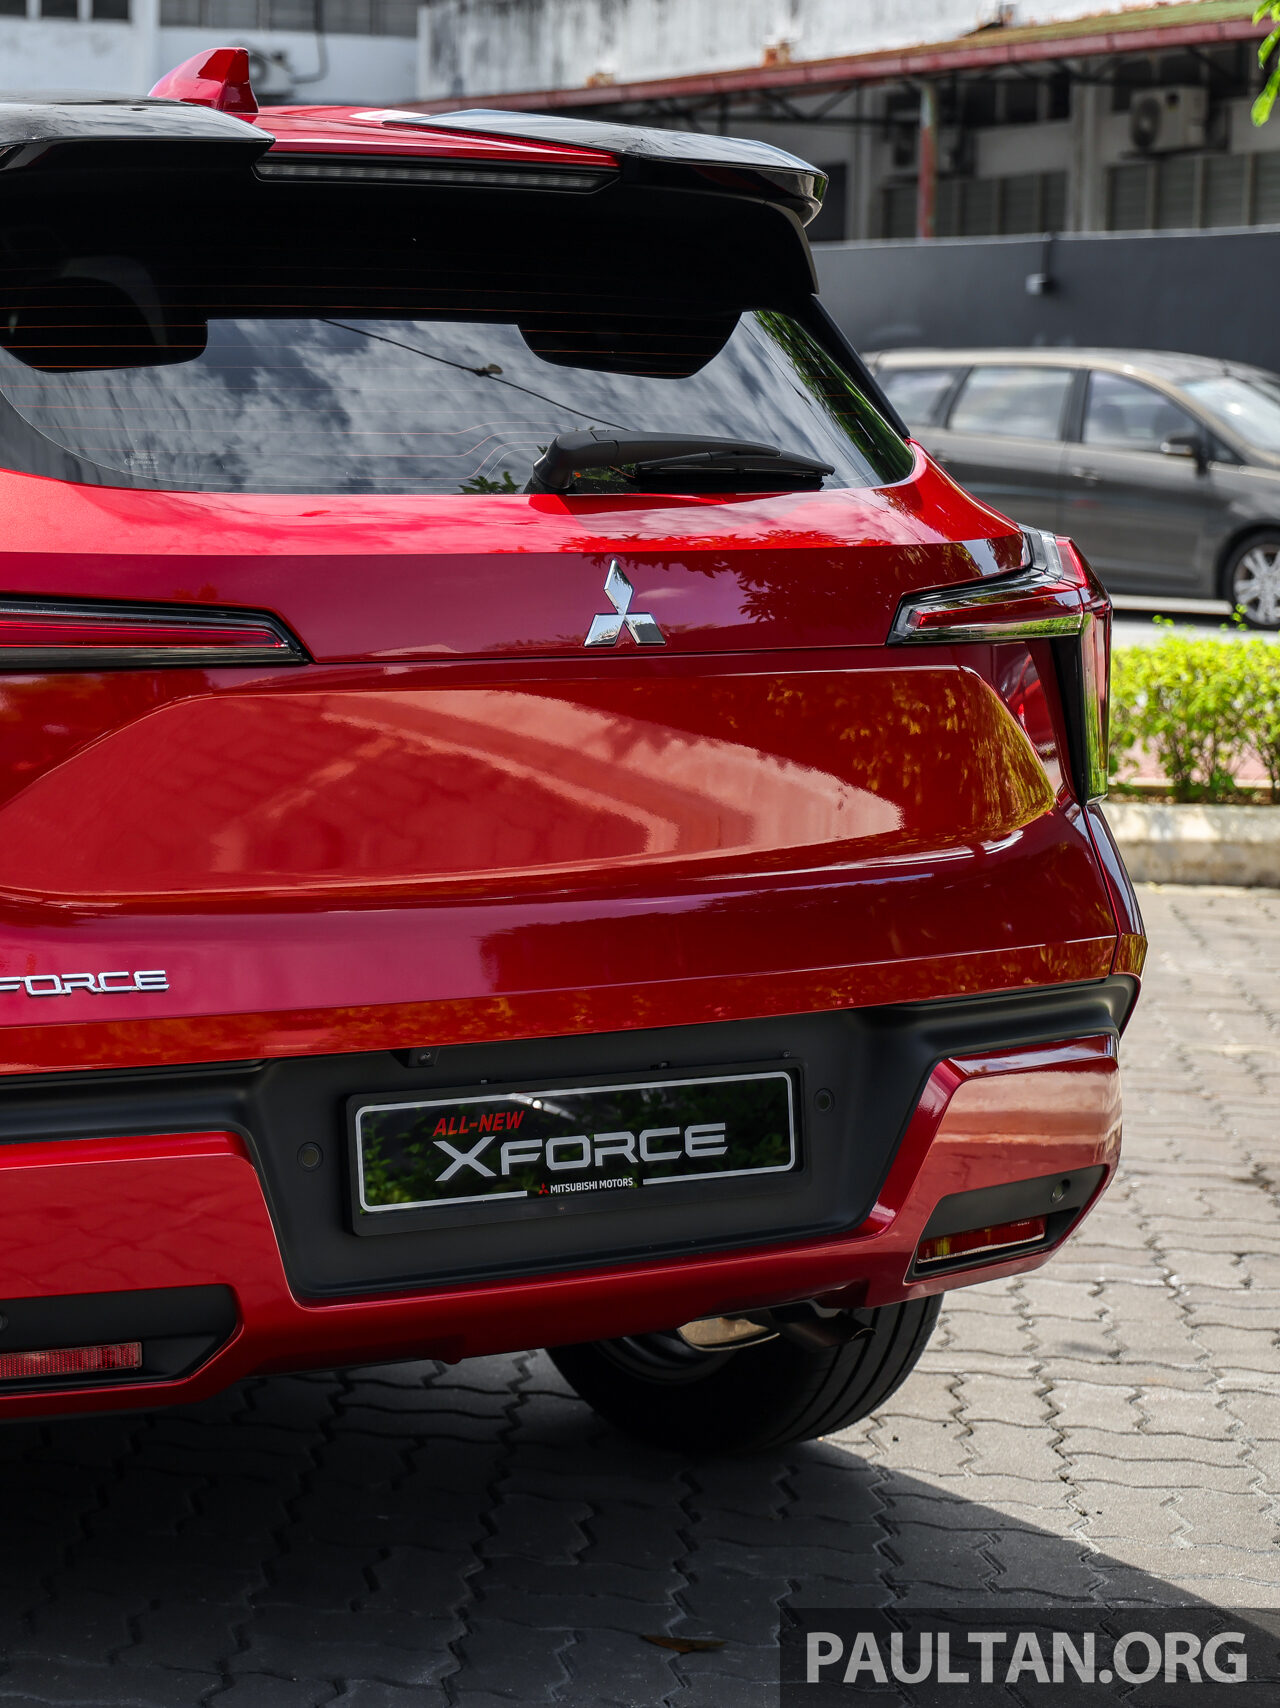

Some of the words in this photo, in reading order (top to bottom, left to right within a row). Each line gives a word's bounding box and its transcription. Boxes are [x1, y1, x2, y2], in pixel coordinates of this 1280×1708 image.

[433, 1110, 525, 1137] ALL-NEW
[433, 1122, 729, 1182] XFORCE
[550, 1180, 598, 1194] MITSUBISHI
[599, 1177, 634, 1189] MOTORS
